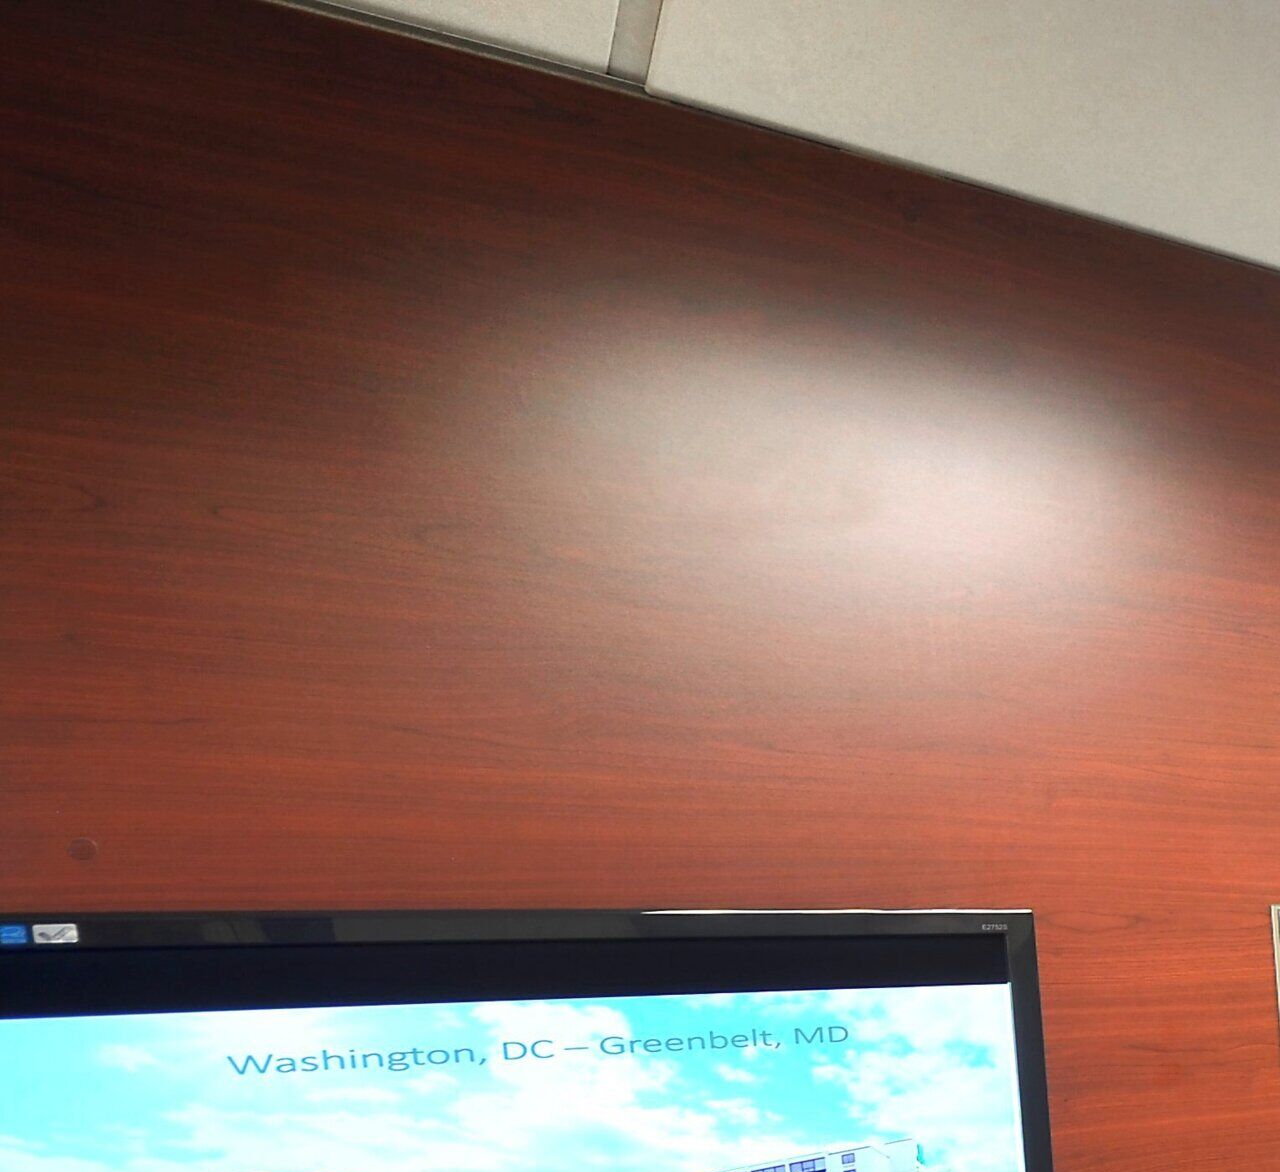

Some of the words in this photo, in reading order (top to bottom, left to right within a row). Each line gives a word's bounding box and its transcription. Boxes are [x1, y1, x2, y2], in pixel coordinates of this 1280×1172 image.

[226, 1048, 487, 1075] Washington,
[502, 1040, 555, 1060] DC
[600, 1028, 781, 1055] Greenbelt,
[794, 1026, 849, 1044] MD
